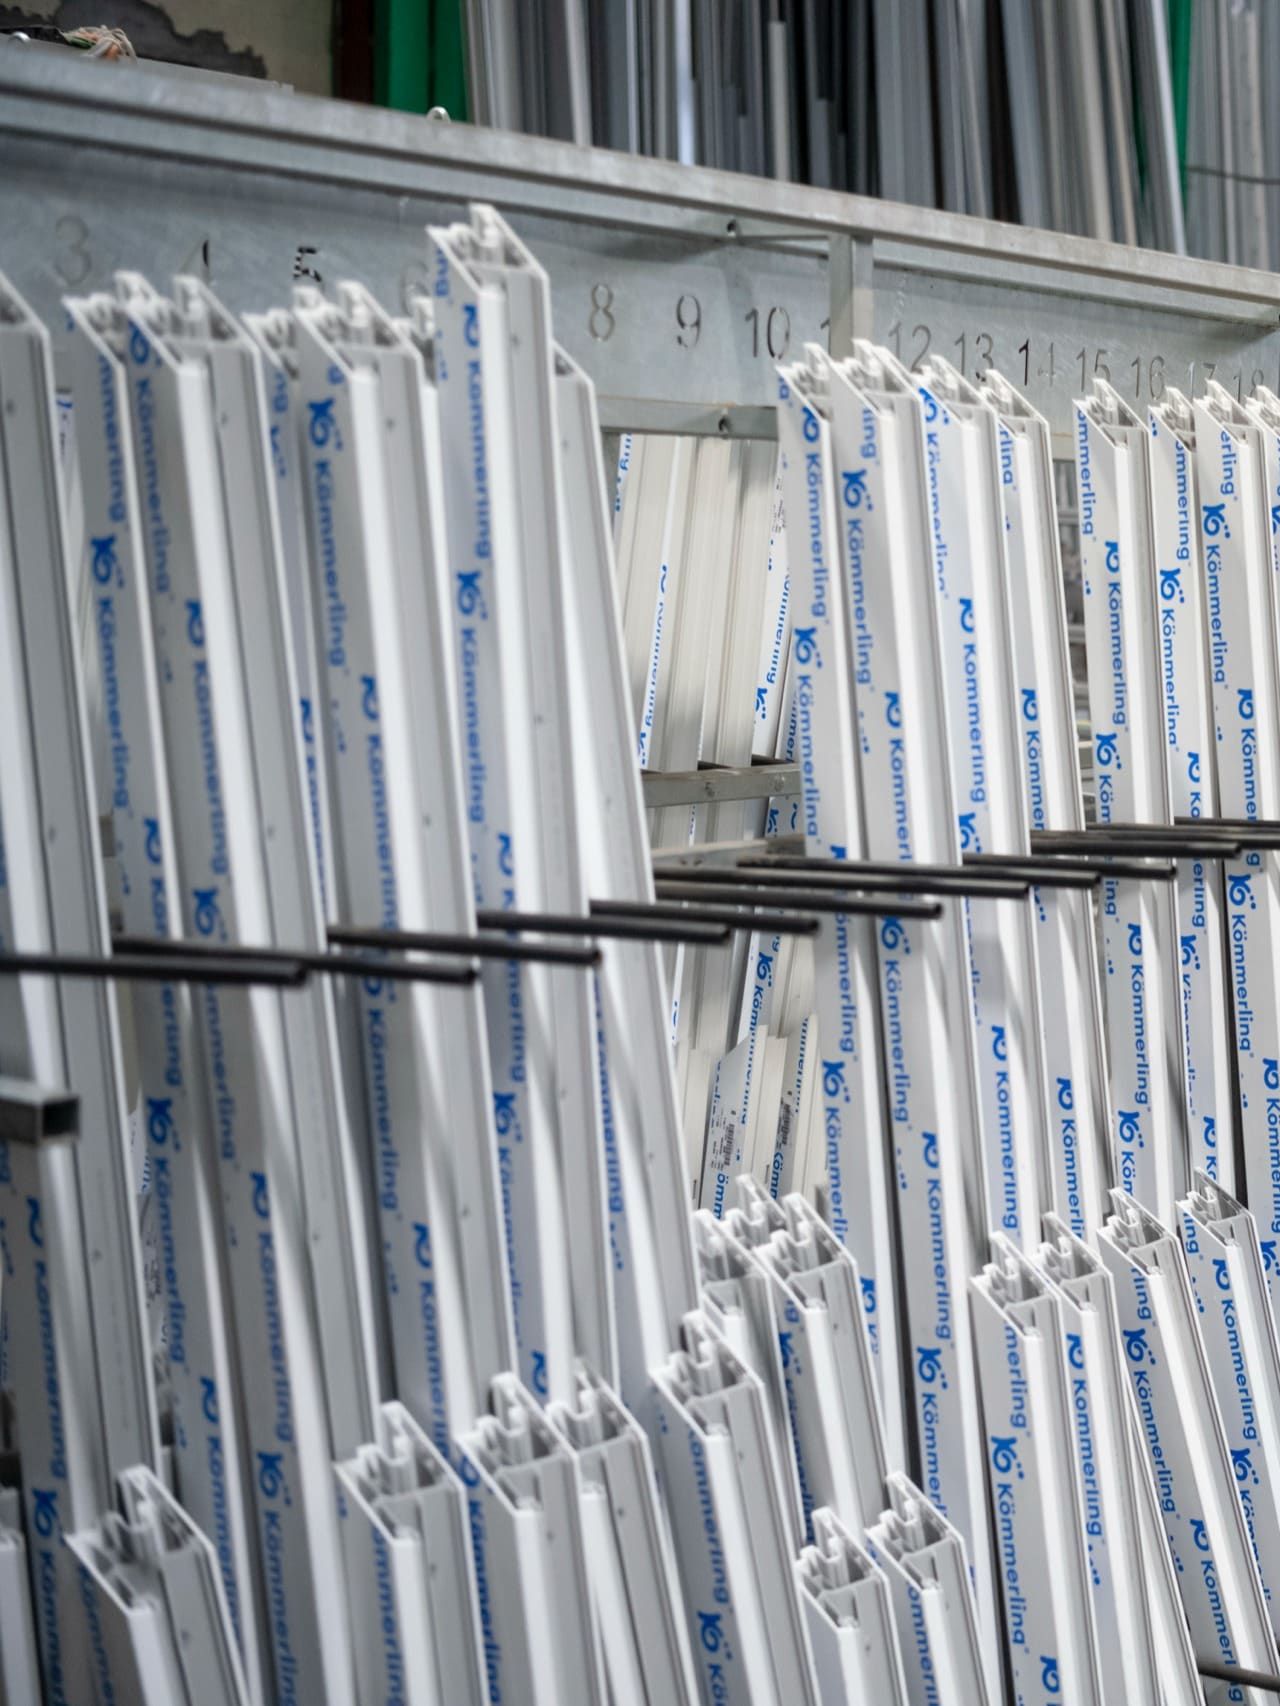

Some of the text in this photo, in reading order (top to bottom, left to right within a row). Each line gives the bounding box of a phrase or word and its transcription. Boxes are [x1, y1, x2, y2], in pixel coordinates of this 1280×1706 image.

[588, 283, 616, 342] 8
[675, 294, 702, 349] 9
[744, 306, 791, 360] 10
[888, 322, 933, 374] 12
[954, 331, 995, 383] 13
[1076, 347, 1112, 392] 15
[1131, 355, 1167, 400] 16
[846, 518, 874, 685] Kömmerling
[884, 959, 912, 1122] Kömmerling
[1130, 963, 1151, 1106] Kömmerling
[1133, 1369, 1178, 1514] Kömmerling
